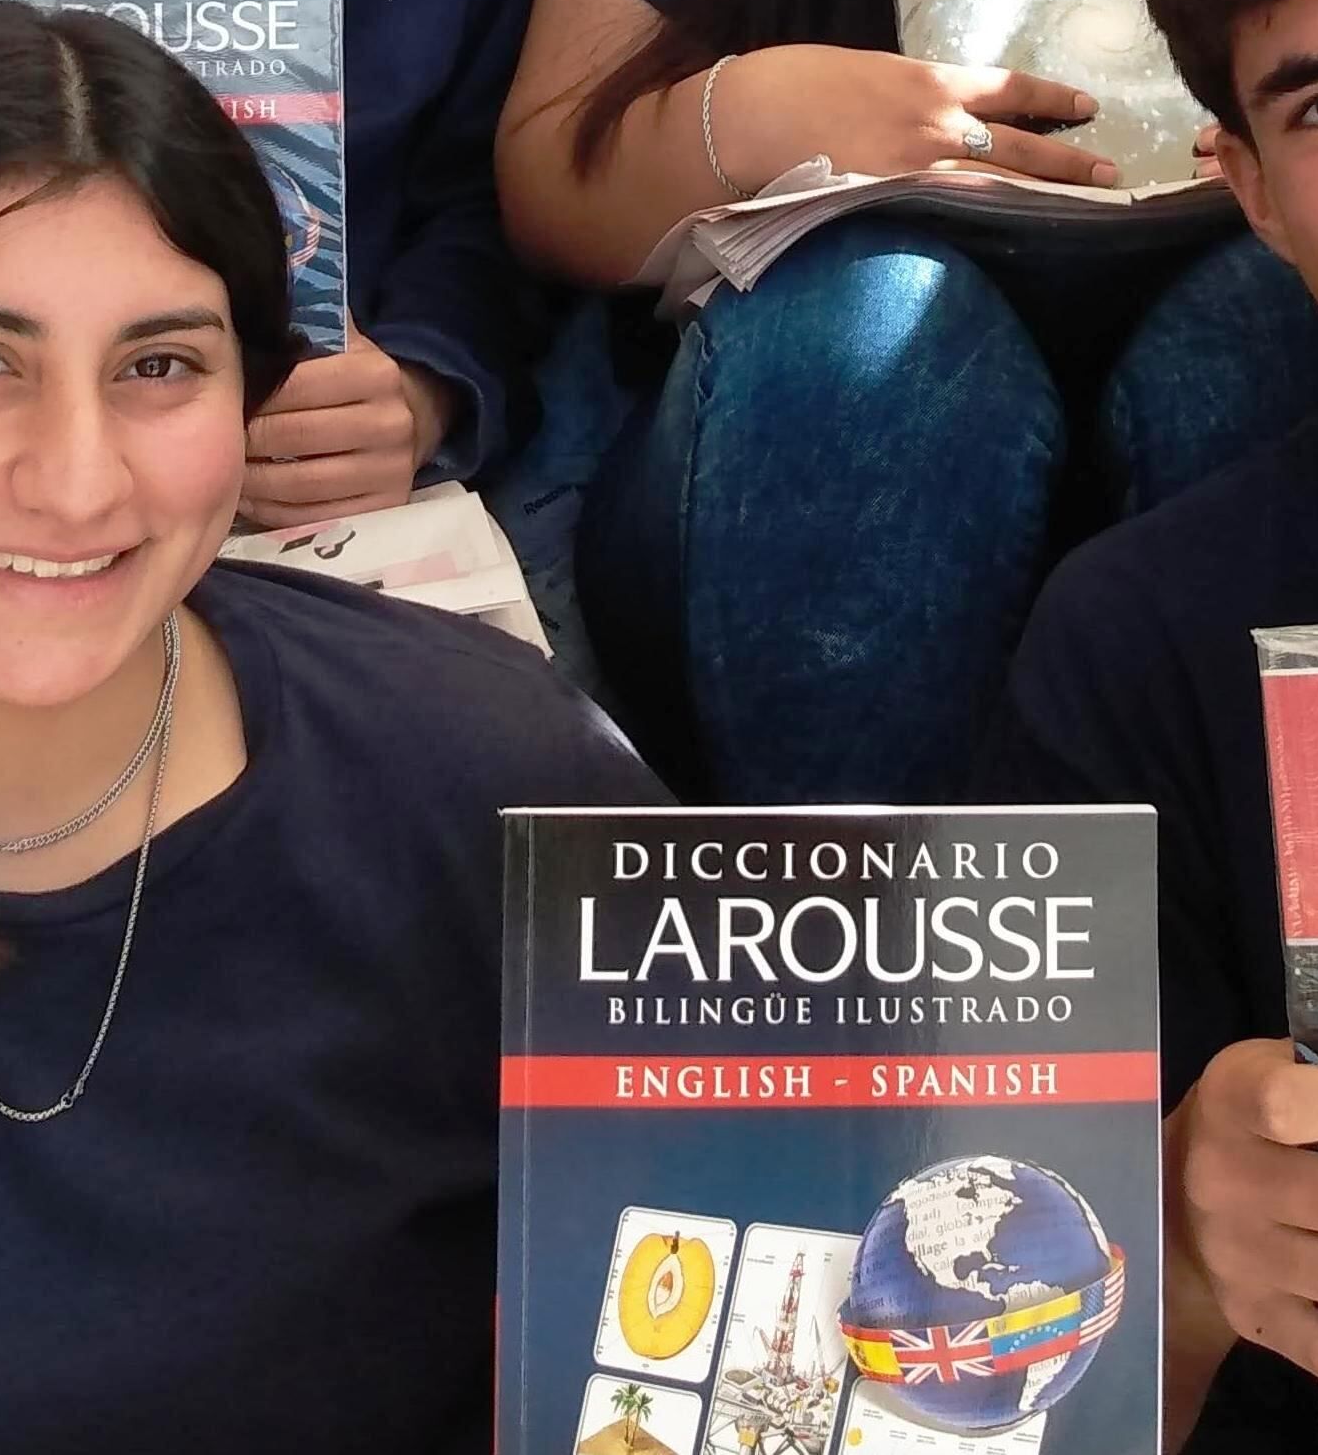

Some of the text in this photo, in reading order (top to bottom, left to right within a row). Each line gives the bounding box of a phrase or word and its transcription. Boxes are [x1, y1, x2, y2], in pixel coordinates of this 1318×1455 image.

[612, 841, 1061, 882] DICCIONARIO
[579, 895, 1096, 983] LAROUSSE
[608, 992, 1073, 1026] BILINGÜE ILUSTRADO
[615, 1065, 813, 1098] ENGLISH
[870, 1063, 1060, 1097] SPANISH
